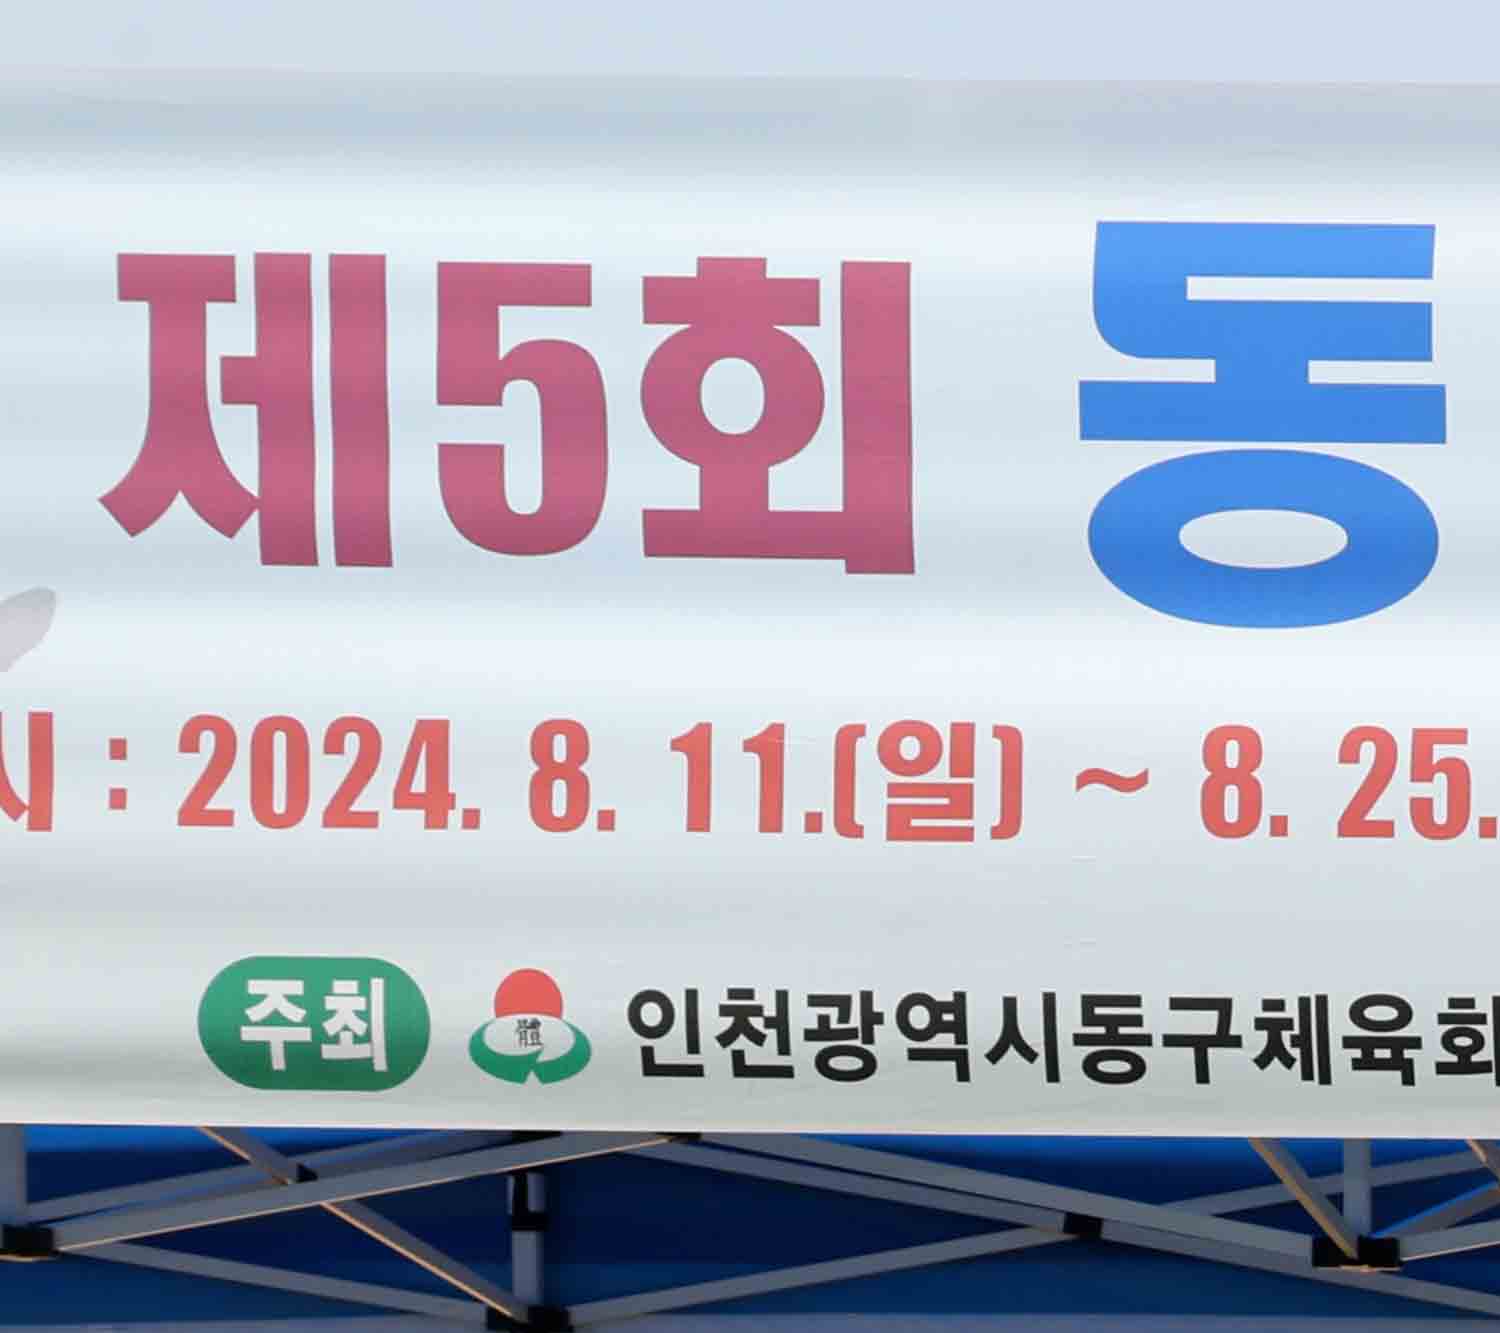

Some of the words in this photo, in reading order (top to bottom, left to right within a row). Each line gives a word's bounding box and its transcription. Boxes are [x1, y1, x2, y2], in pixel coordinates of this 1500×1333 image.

[99, 250, 917, 576] 제5회
[177, 713, 481, 830] 2024.
[529, 717, 616, 833] 8.
[669, 721, 1024, 844] 11.(일)
[1200, 723, 1289, 840] 8.
[238, 976, 391, 1074] 주최
